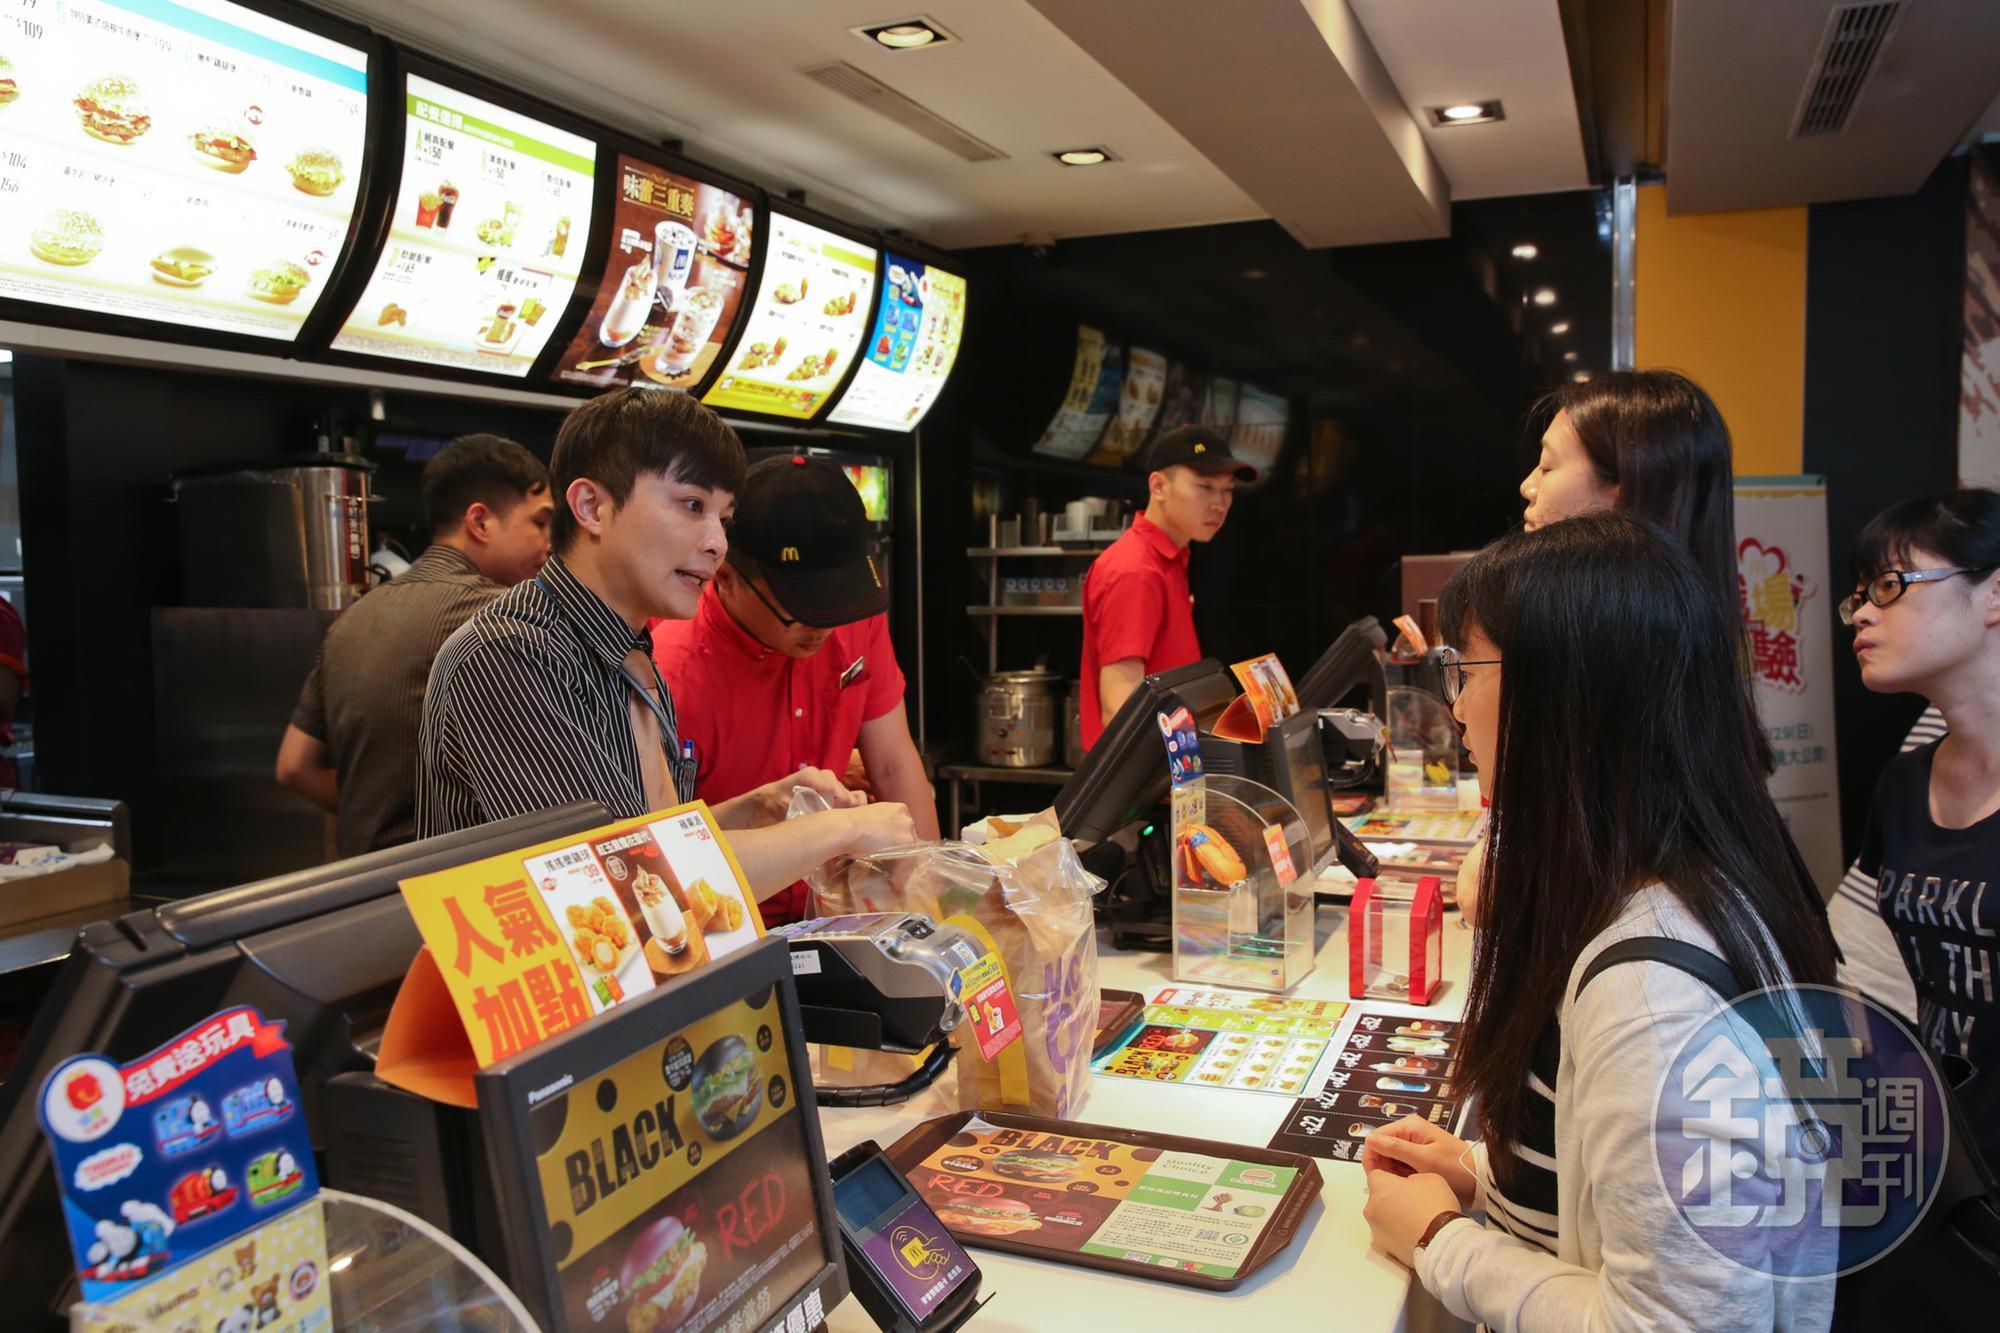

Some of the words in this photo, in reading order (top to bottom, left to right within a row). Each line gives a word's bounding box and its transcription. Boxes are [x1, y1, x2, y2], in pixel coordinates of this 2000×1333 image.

[623, 174, 695, 217] 味蕾三重奏
[442, 879, 558, 979] 人氣
[1940, 940, 2000, 1003] TH
[472, 957, 594, 1061] 加點
[125, 1012, 256, 1102] 免費送玩具
[565, 1093, 684, 1217] BLACK
[990, 1128, 1120, 1161] BLACK
[1162, 1162, 1209, 1176] Choice
[1166, 1157, 1215, 1172] Quality
[714, 1169, 786, 1261] RED
[928, 1173, 1005, 1198] RED
